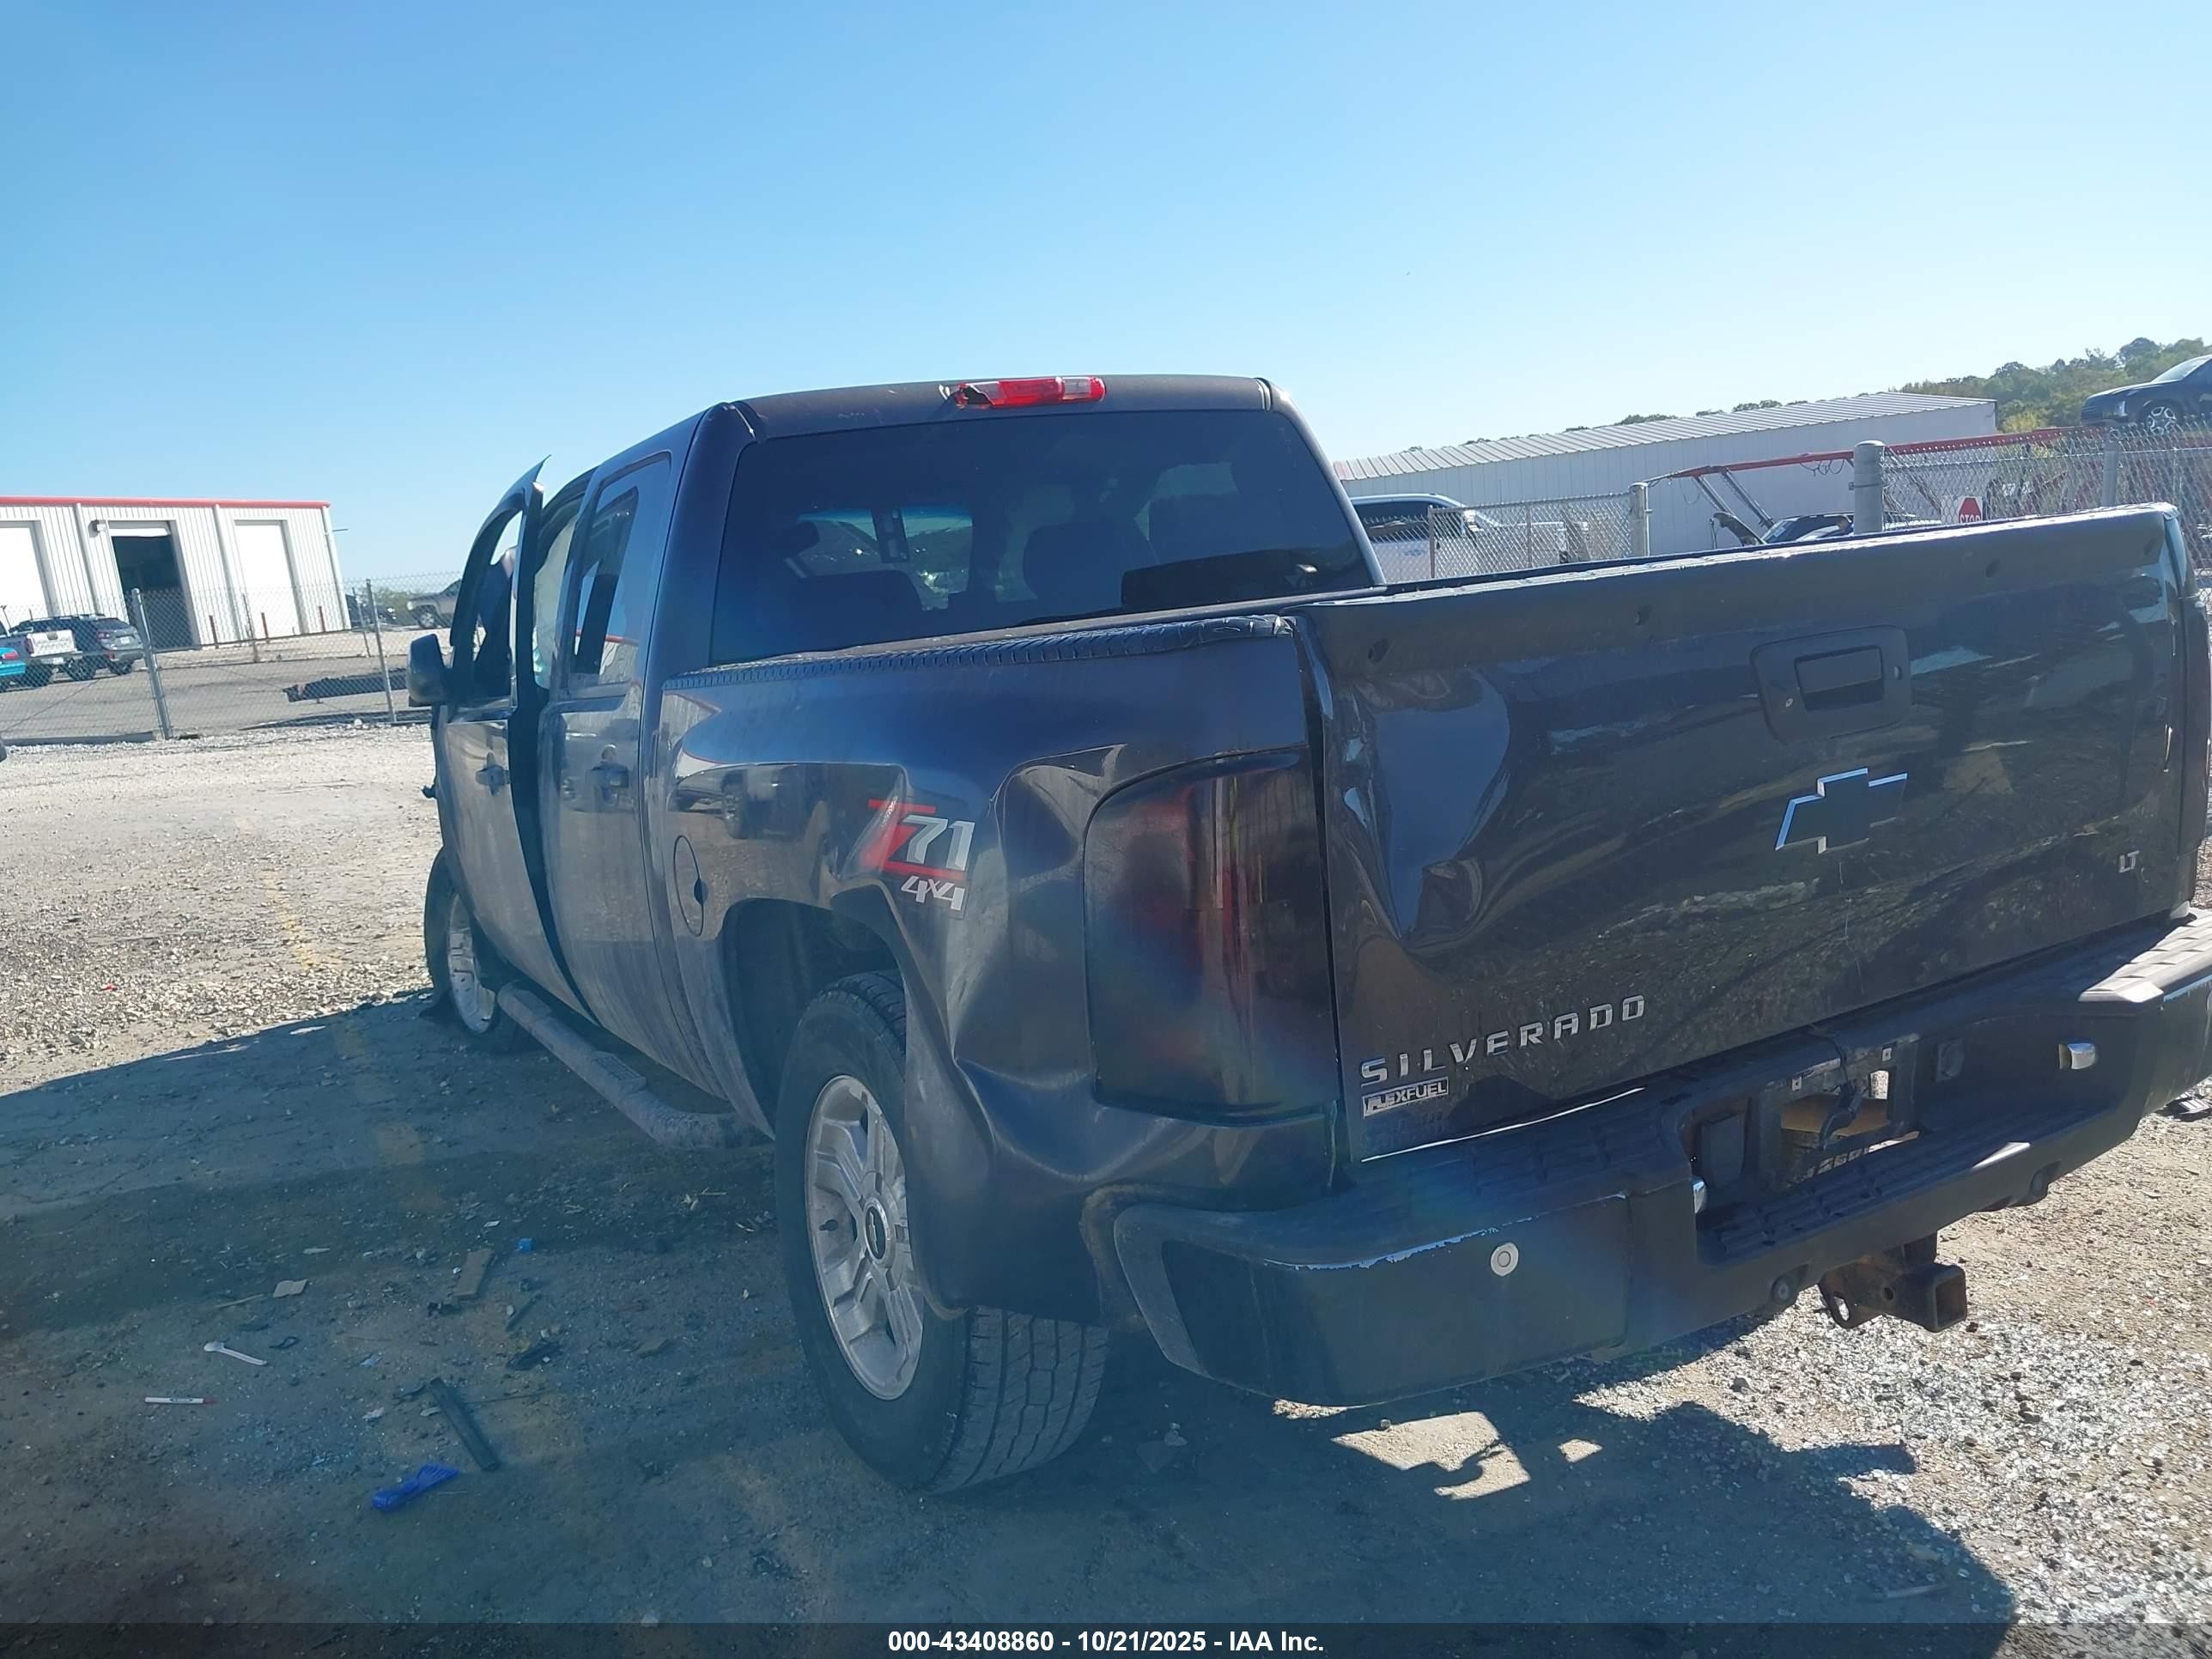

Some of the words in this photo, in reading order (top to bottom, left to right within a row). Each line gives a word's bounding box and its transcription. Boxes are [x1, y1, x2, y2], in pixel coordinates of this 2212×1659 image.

[860, 799, 975, 880] Z71
[2118, 850, 2140, 873] LT
[1360, 994, 1645, 1088] SILVERADO
